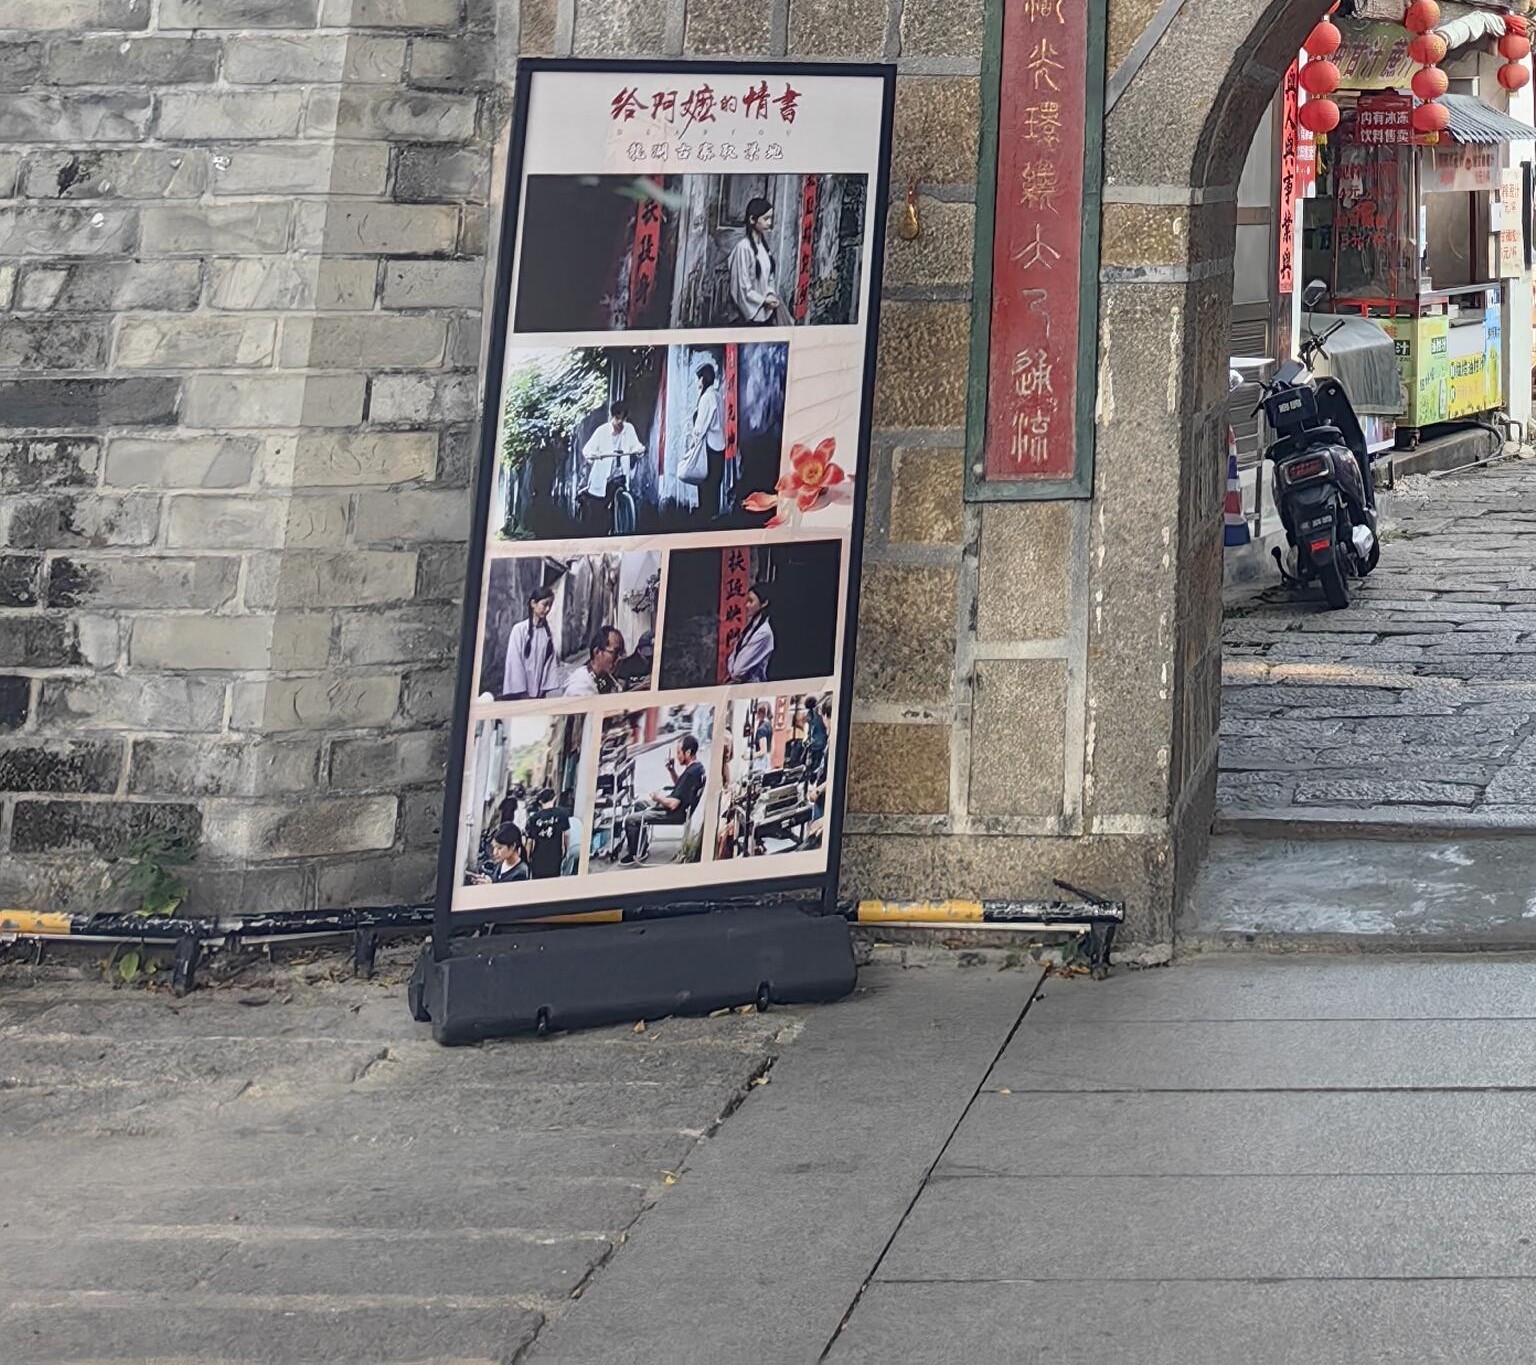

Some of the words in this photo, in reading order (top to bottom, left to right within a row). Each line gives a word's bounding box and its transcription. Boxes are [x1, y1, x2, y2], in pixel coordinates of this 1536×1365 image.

[1360, 111, 1409, 126] 内有冰冻
[1360, 128, 1409, 143] 饮料售卖
